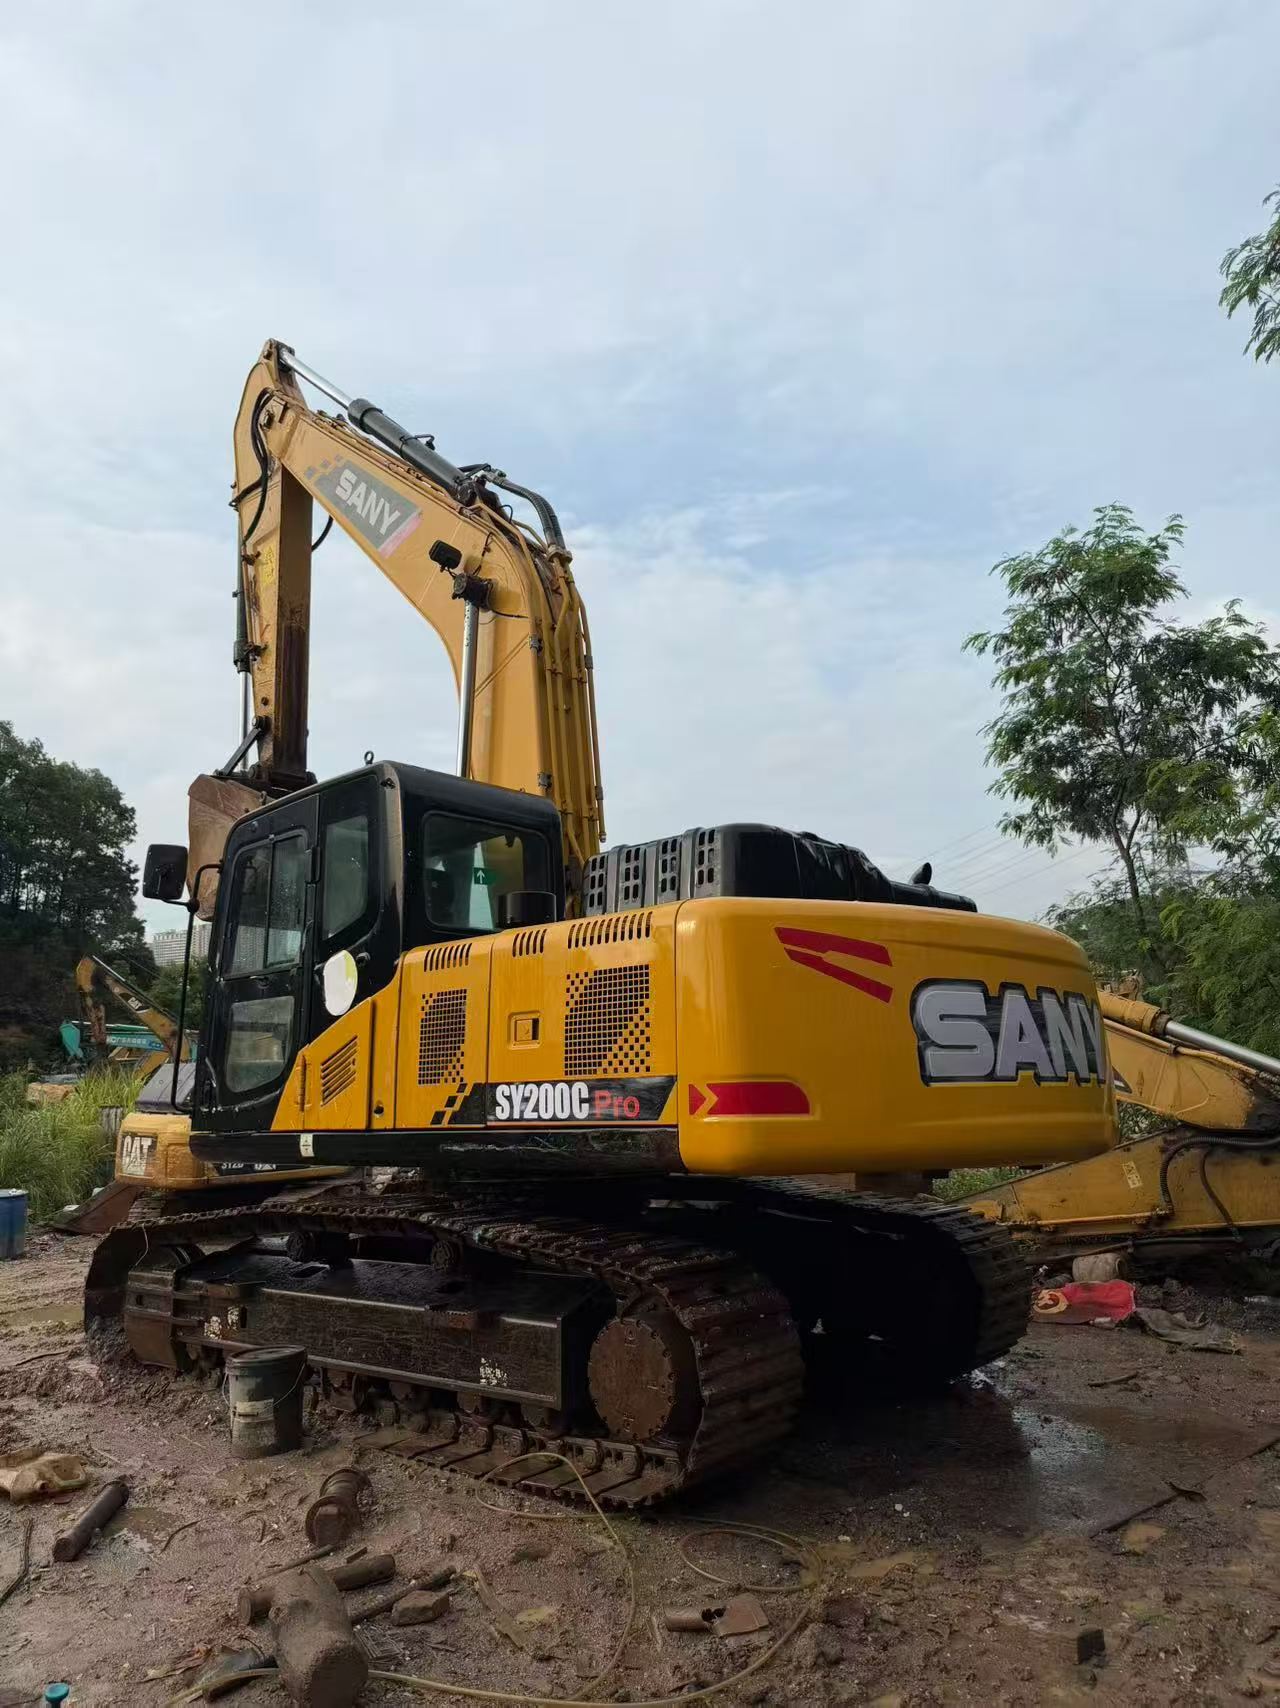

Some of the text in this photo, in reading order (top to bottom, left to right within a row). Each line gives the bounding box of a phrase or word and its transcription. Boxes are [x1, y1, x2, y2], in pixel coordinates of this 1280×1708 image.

[335, 468, 401, 535] SANY
[495, 1081, 641, 1120] SY200C Pro
[122, 1135, 153, 1175] CAT
